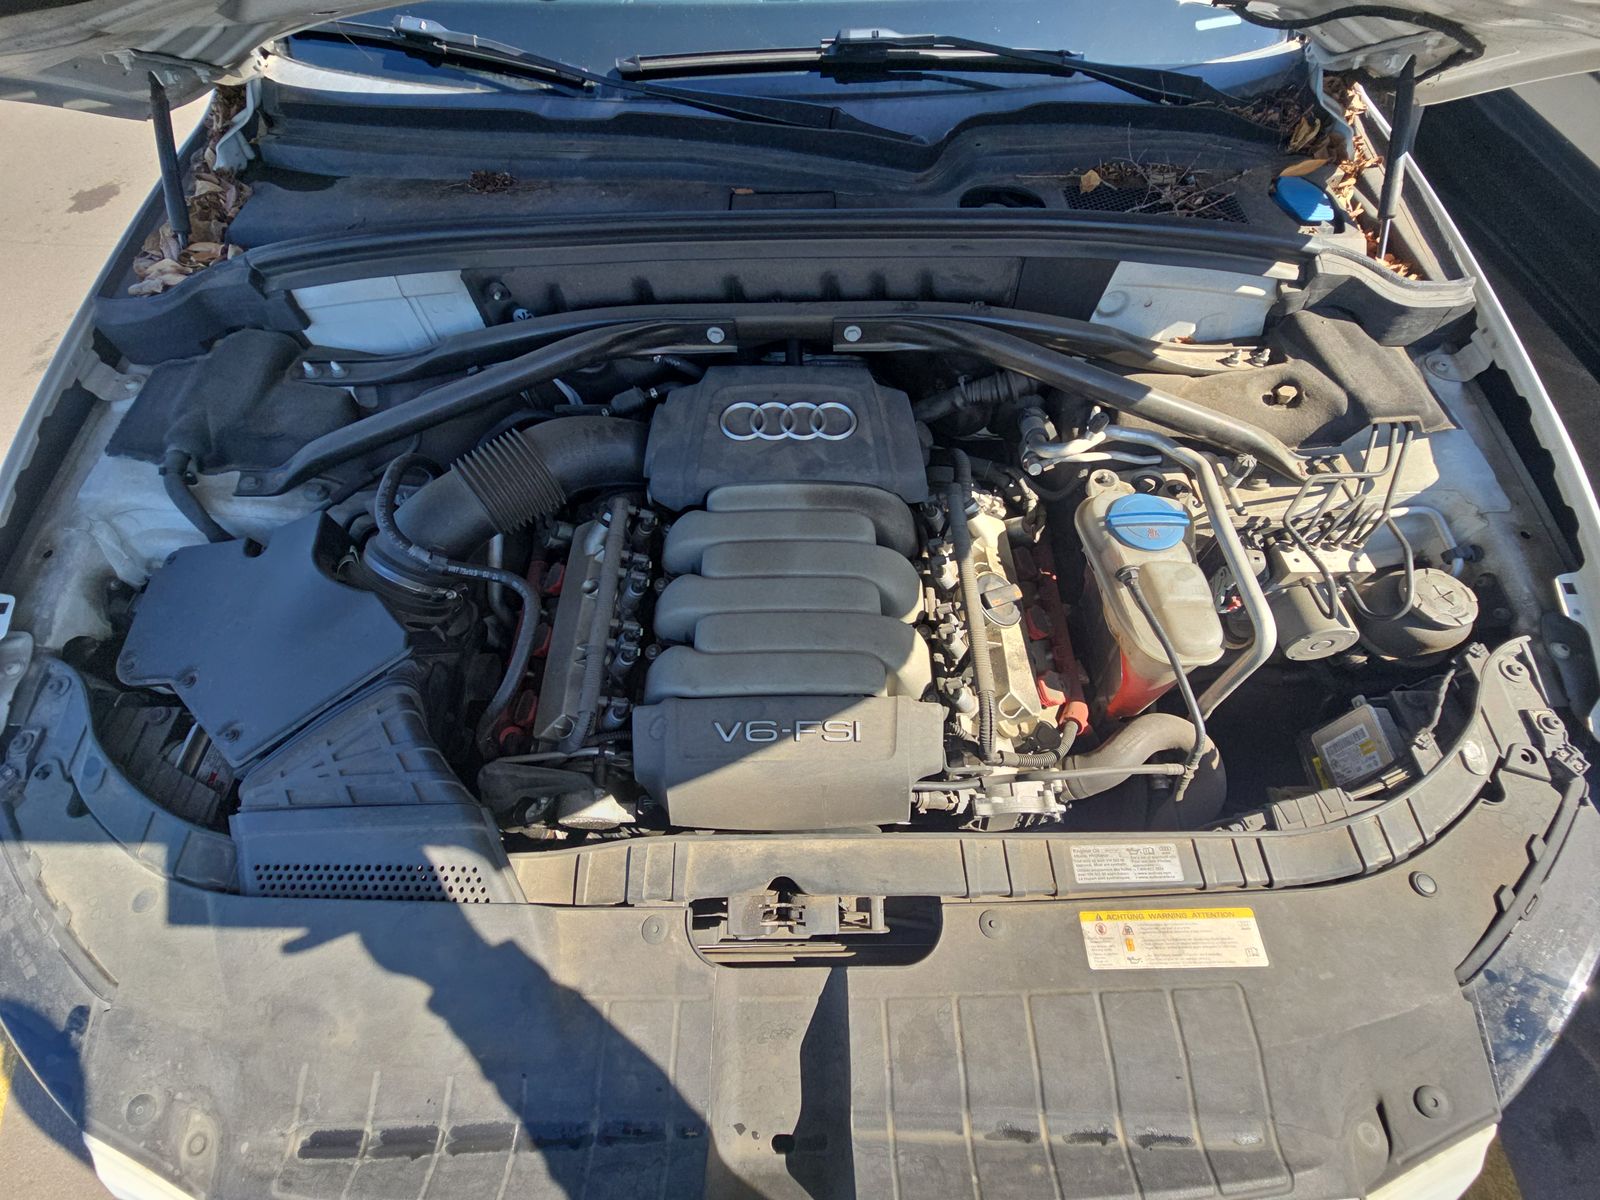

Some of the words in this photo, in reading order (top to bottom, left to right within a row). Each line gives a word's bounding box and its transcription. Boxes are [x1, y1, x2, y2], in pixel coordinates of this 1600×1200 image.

[713, 720, 862, 743] V6-FSI
[1106, 912, 1145, 921] ACHTUNG
[1148, 911, 1188, 920] WARNING
[1191, 911, 1236, 919] ATTENTION
